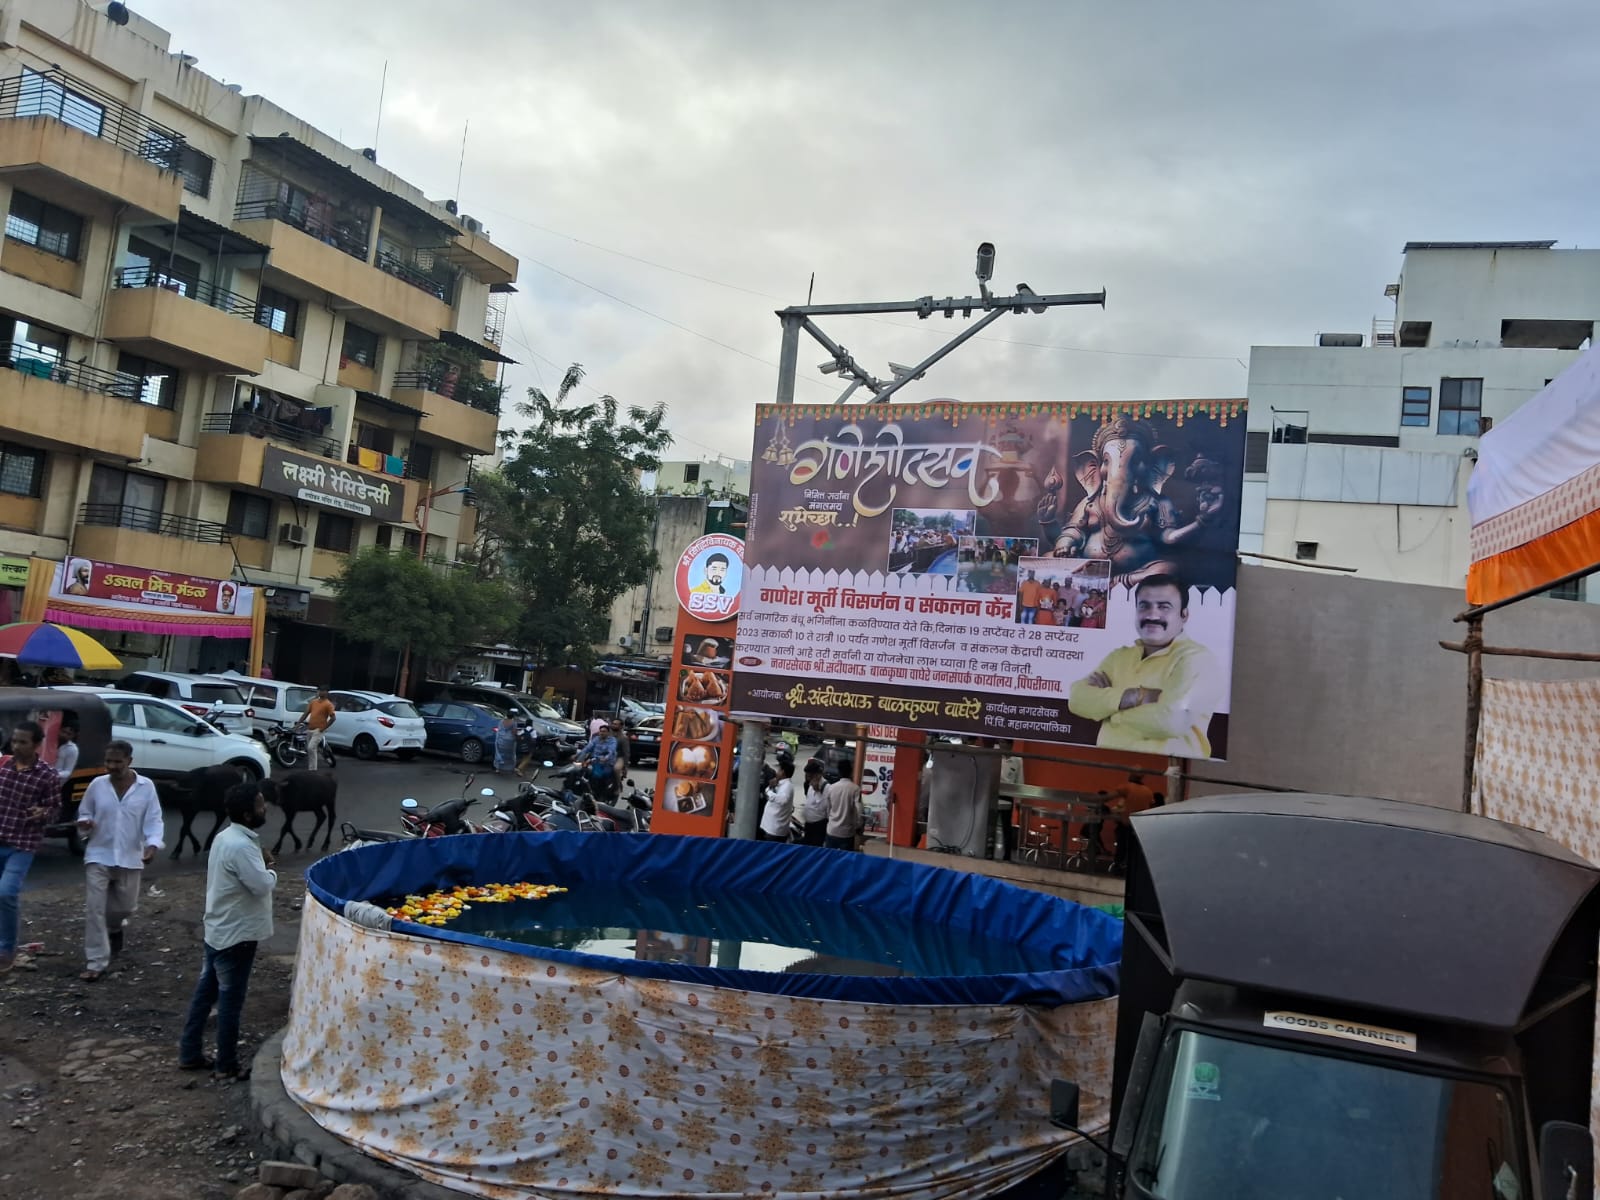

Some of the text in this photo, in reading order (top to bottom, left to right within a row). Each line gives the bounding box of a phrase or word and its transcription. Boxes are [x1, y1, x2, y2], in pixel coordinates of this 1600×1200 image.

[282, 461, 391, 506] लक्ष्मी रेसिडेन्सी
[790, 424, 1002, 517] गणेशोत्सव
[148, 575, 174, 594] मित्र
[176, 580, 208, 598] मंडळ
[689, 591, 734, 614] SSV
[760, 585, 1013, 620] गणेश मूर्ती विसर्जन व संकलन केंद्र
[754, 612, 789, 624] नागरिक
[848, 617, 900, 632] कळविण्यात
[902, 619, 917, 631] येते
[969, 626, 980, 636] 19
[1018, 627, 1027, 640] ते
[1028, 630, 1042, 641] 28
[735, 643, 770, 655] करण्यात
[773, 644, 795, 657] आली
[796, 646, 813, 659] आहे
[815, 646, 831, 660] तरी
[863, 652, 874, 662] या
[876, 653, 914, 665] योजनेचा
[916, 655, 938, 667] लाभ
[968, 658, 978, 671] हि
[980, 662, 998, 673] नम्र
[736, 627, 759, 638] 2023
[760, 628, 793, 640] सकाळी
[795, 631, 805, 641] 10
[807, 630, 816, 642] ते
[815, 630, 837, 644] रात्री
[837, 634, 846, 644] 10
[871, 634, 896, 648] गणेश
[899, 636, 917, 651] मूर्ती
[919, 638, 955, 652] विसर्जन
[960, 643, 968, 652] व
[970, 641, 1008, 655] संकलन
[1045, 650, 1085, 662] व्यवस्था
[771, 658, 812, 671] नगरसेवक
[870, 665, 907, 681] बाळकृष्ण
[909, 668, 931, 681] वाघेरे
[974, 673, 1012, 688] कार्यालय
[877, 696, 940, 722] बाळकृष्ण
[944, 696, 982, 720] वाघेरे
[985, 702, 1059, 718] कार्यक्षम नगरसेवक
[1007, 719, 1072, 734] महानगरपालिका
[1273, 1014, 1407, 1045] GOODS CARRIER
